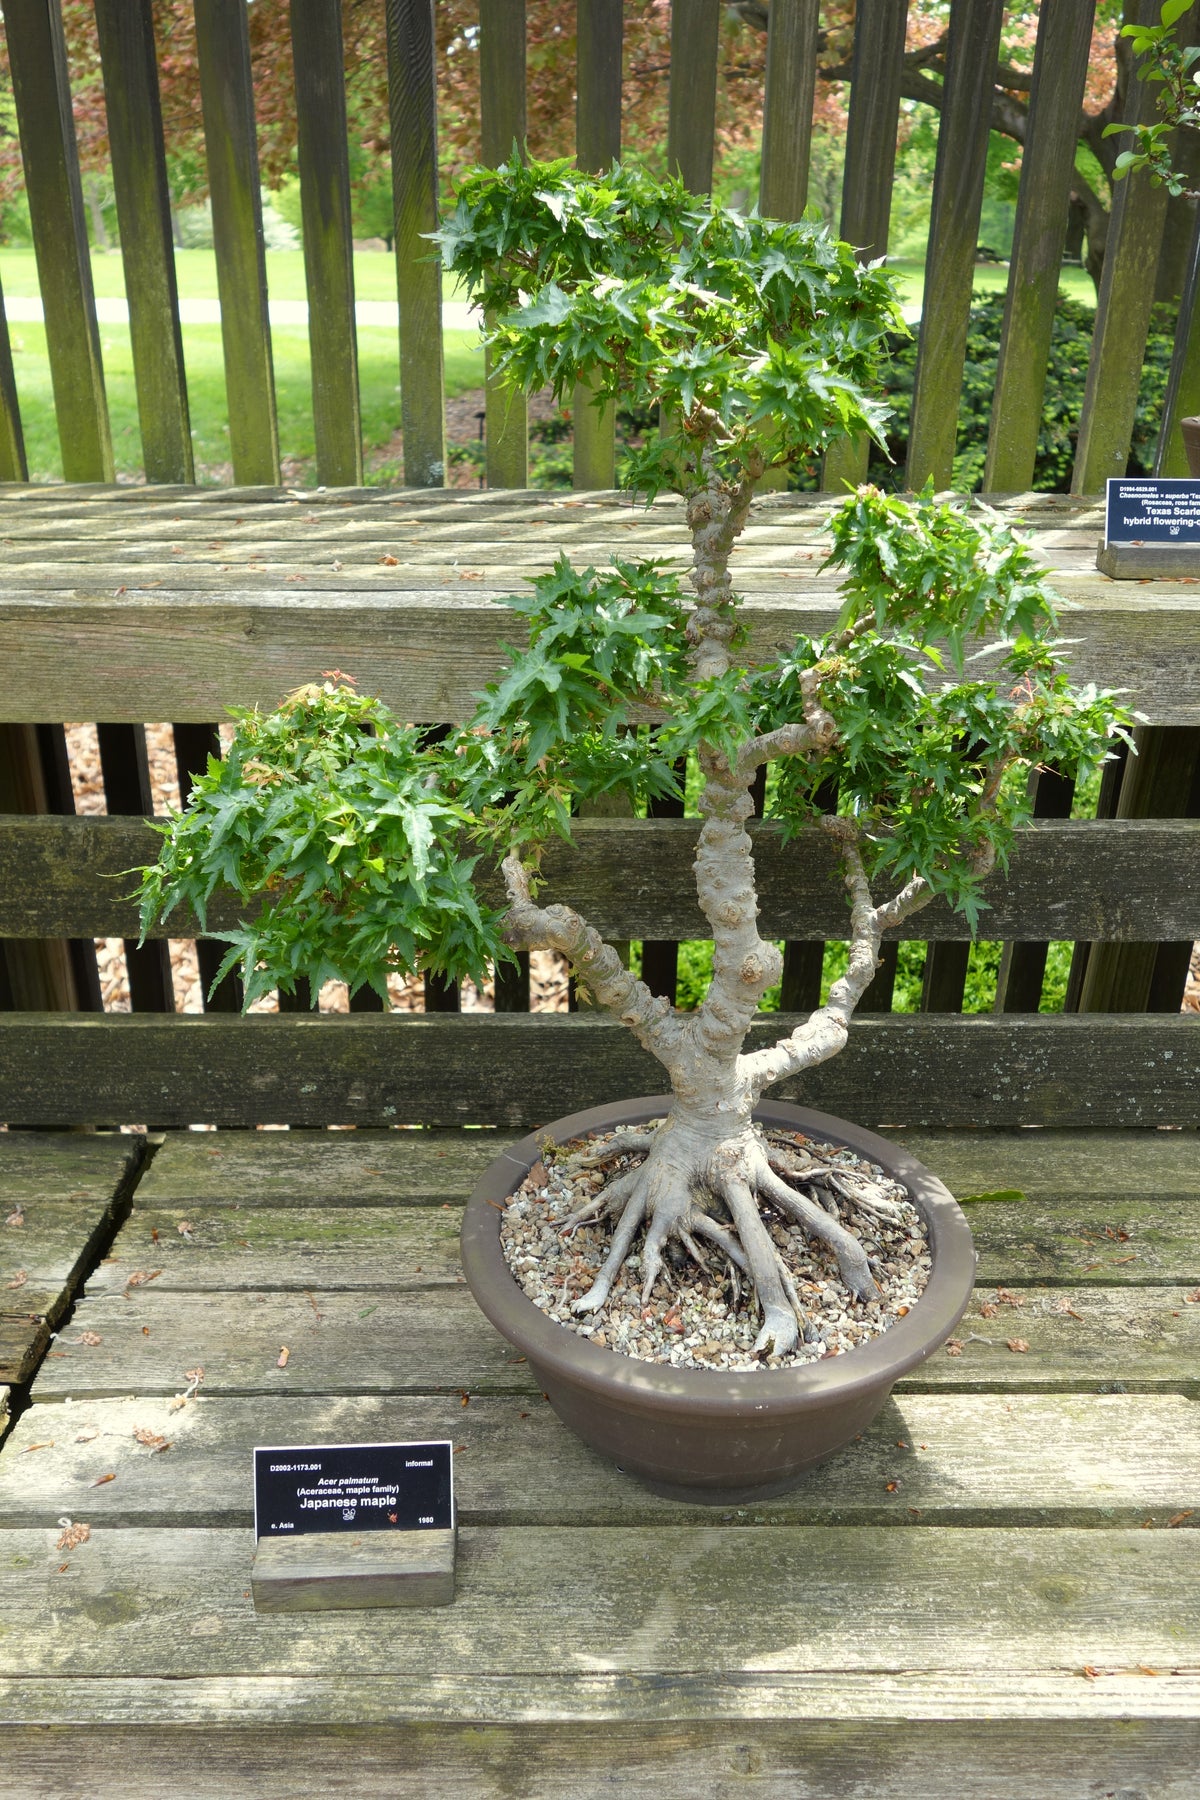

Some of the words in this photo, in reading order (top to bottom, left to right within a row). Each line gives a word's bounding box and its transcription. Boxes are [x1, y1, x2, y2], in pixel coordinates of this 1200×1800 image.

[1146, 507, 1172, 515] Texas
[1123, 516, 1152, 526] hybrid
[317, 1477, 338, 1486] Acer
[338, 1476, 379, 1487] palmatum
[296, 1487, 344, 1497] (Aceraceae,
[345, 1486, 371, 1495] maple
[371, 1484, 400, 1494] family)
[300, 1498, 357, 1510] Japanese
[360, 1495, 397, 1508] maple
